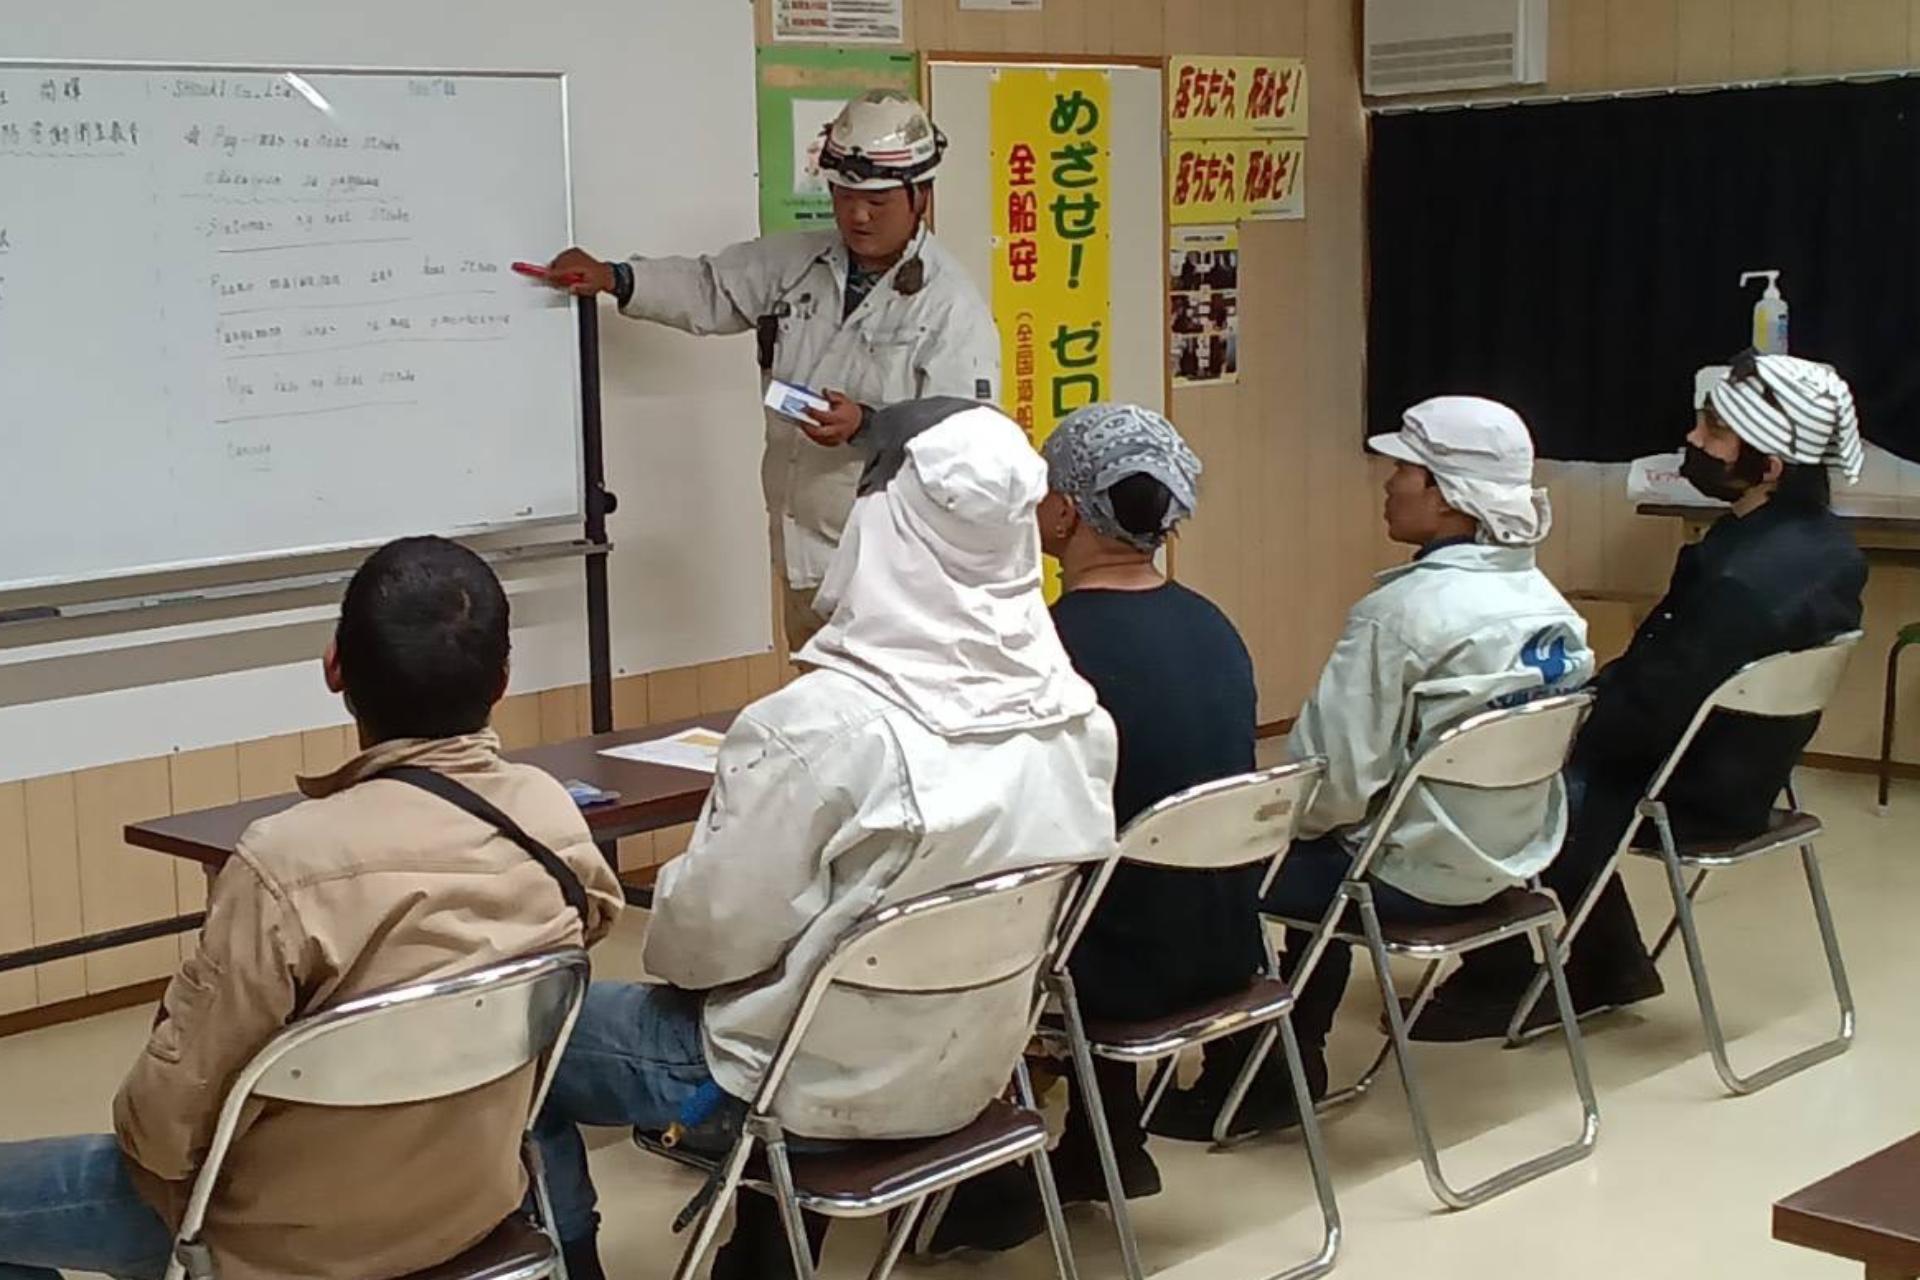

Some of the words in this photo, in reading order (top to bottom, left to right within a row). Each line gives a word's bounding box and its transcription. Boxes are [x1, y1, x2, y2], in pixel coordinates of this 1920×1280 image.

[1172, 65, 1237, 119] 落ちたら
[1049, 90, 1101, 289] めざせ!
[1172, 151, 1236, 205] 落ちたら
